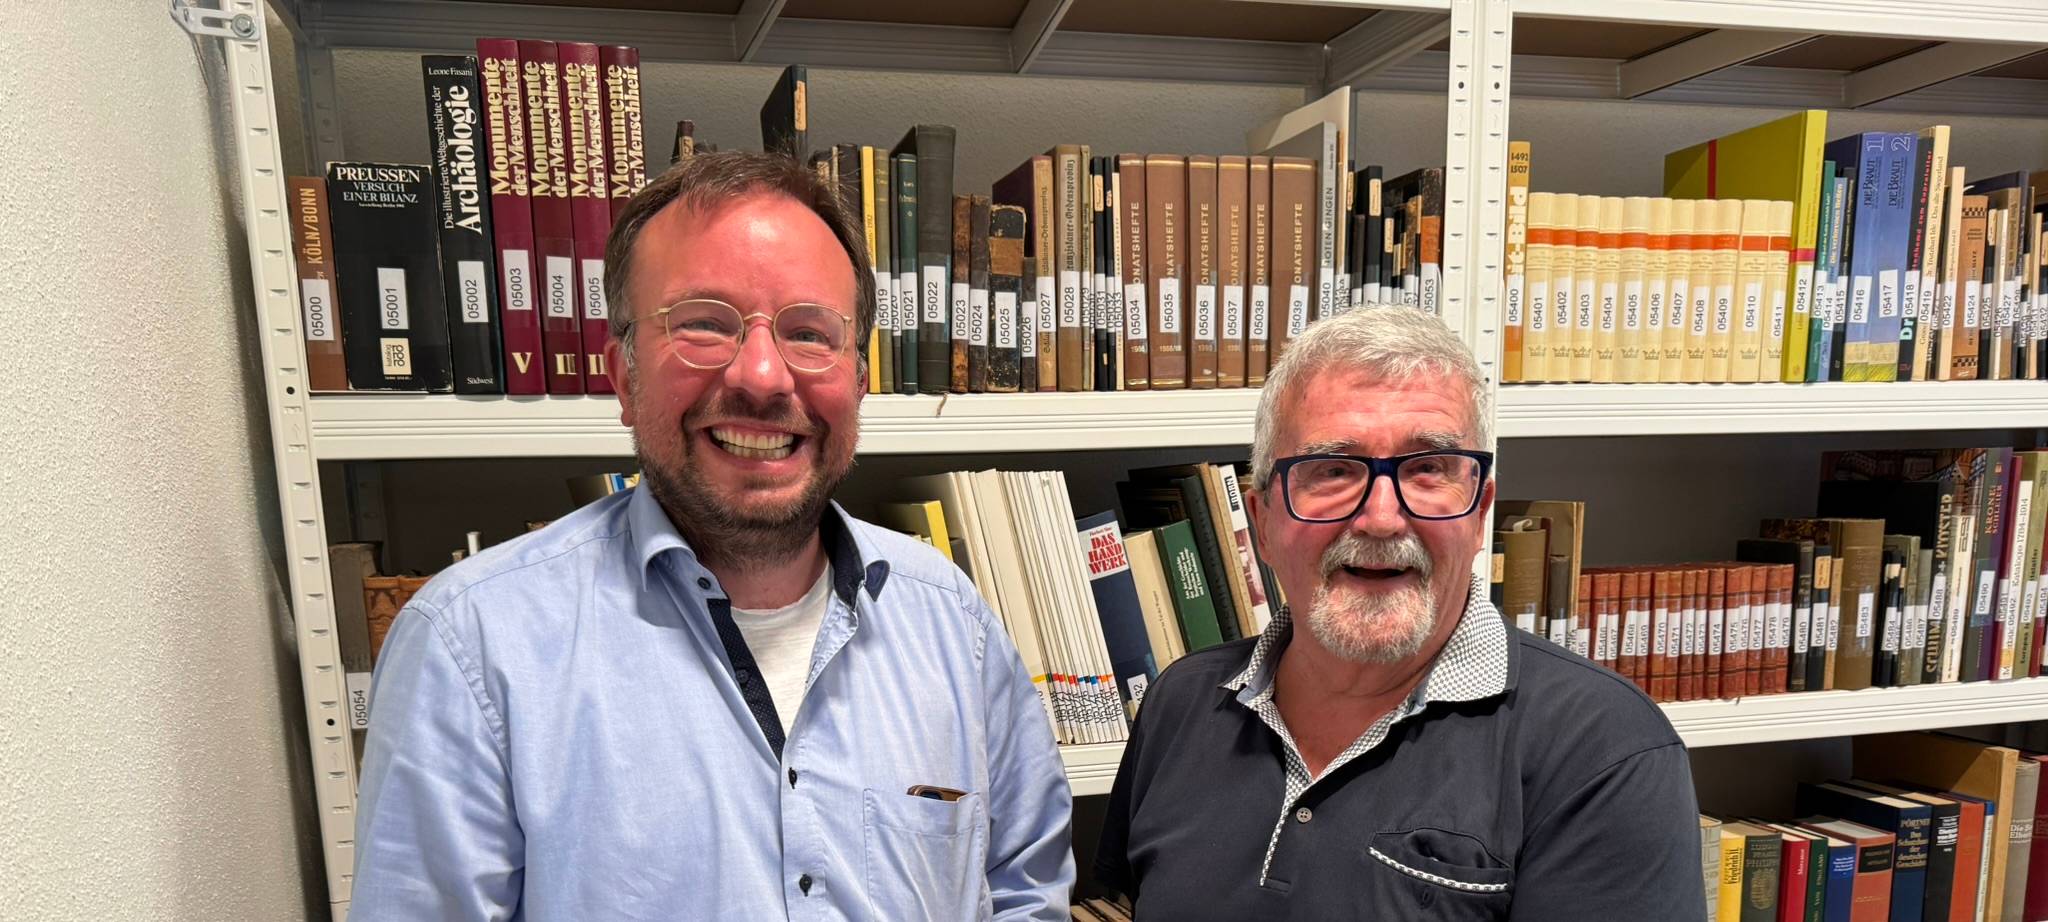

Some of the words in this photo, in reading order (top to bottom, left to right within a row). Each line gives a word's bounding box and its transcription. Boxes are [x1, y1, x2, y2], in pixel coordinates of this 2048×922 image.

[428, 67, 450, 76] Leone
[450, 68, 473, 77] Fasani
[431, 85, 441, 99] der
[482, 57, 511, 196] Monumente
[523, 60, 551, 197] Monumente
[564, 62, 591, 198] Monumente
[605, 64, 630, 199] Monumente
[445, 85, 482, 235] Archäologie
[1866, 136, 1885, 152] 1
[1891, 136, 1911, 152] 2
[337, 167, 420, 183] PREUSSEN
[353, 182, 405, 192] VERSUCH
[343, 192, 379, 202] EINER
[379, 193, 418, 203] BILANZ
[300, 188, 323, 264] KÖLN/BONN
[444, 213, 455, 229] Die
[1131, 202, 1140, 284] ONATSHEFTE
[1201, 203, 1209, 285] ONATSHEFTE
[1230, 204, 1239, 286] ONATSHEFTE
[1256, 203, 1265, 285] ONATSHEFTE
[1294, 203, 1303, 284] ONATSHEFTE
[465, 279, 480, 319] 05002
[511, 267, 525, 307] 05003
[552, 275, 566, 314] 05004
[590, 277, 603, 316] 05005
[928, 281, 938, 319] 05022
[1321, 282, 1331, 317] 05040
[1424, 278, 1434, 313] 05053
[1796, 279, 1808, 311] 05412
[1814, 285, 1825, 317] 05413
[1882, 285, 1893, 315] 05417
[1905, 284, 1915, 315] 05418
[310, 296, 324, 337] 05000
[385, 287, 400, 327] 05001
[878, 288, 889, 326] 05019
[902, 290, 914, 327] 05021
[956, 299, 966, 337] 05023
[1042, 293, 1052, 329] 05027
[1065, 287, 1075, 323] 05028
[1096, 291, 1106, 326] 05031
[1130, 299, 1140, 335] 05034
[1164, 293, 1174, 329] 05035
[1199, 300, 1209, 335] 05036
[1228, 300, 1237, 335] 05037
[1254, 300, 1264, 335] 05038
[1291, 300, 1303, 335] 05039
[1508, 288, 1519, 322] 05400
[1533, 297, 1543, 329] 05401
[1557, 291, 1567, 324] 05402
[1580, 294, 1590, 327] 05403
[1602, 297, 1612, 329] 05404
[1627, 294, 1638, 327] 05405
[1650, 293, 1660, 326] 05406
[1672, 293, 1683, 325] 05407
[1694, 300, 1705, 332] 05408
[1718, 298, 1728, 330] 05409
[1746, 295, 1756, 327] 05410
[1823, 297, 1833, 328] 05414
[1835, 290, 1845, 322] 05415
[1853, 289, 1865, 321] 05416
[1920, 290, 1933, 322] 05419
[1942, 295, 1953, 326] 05422
[1967, 295, 1976, 325] 05424
[1983, 297, 1991, 328] 05425
[2002, 295, 2011, 325] 05427
[971, 304, 982, 342] 05024
[1000, 308, 1010, 345] 05025
[1022, 316, 1032, 354] 05026
[1773, 306, 1783, 337] 05411
[512, 352, 532, 375] V
[1088, 543, 1122, 562] HAND
[1091, 532, 1116, 549] DAS
[1088, 554, 1127, 574] WERK
[1933, 588, 1944, 617] 05488
[1979, 583, 1989, 612] 05490
[2007, 598, 2017, 626] 05492
[2023, 593, 2033, 621] 05493
[1753, 619, 1762, 648] 05477
[1768, 616, 1777, 646] 05478
[1799, 621, 1808, 651] 05480
[1815, 617, 1825, 645] 05481
[1860, 606, 1869, 635] 05483
[1885, 620, 1896, 648] 05484
[1916, 618, 1926, 646] 05487
[1625, 623, 1636, 654] 05468
[1670, 627, 1678, 655] 05471
[1712, 623, 1721, 653] 05474
[355, 688, 369, 726] 05054
